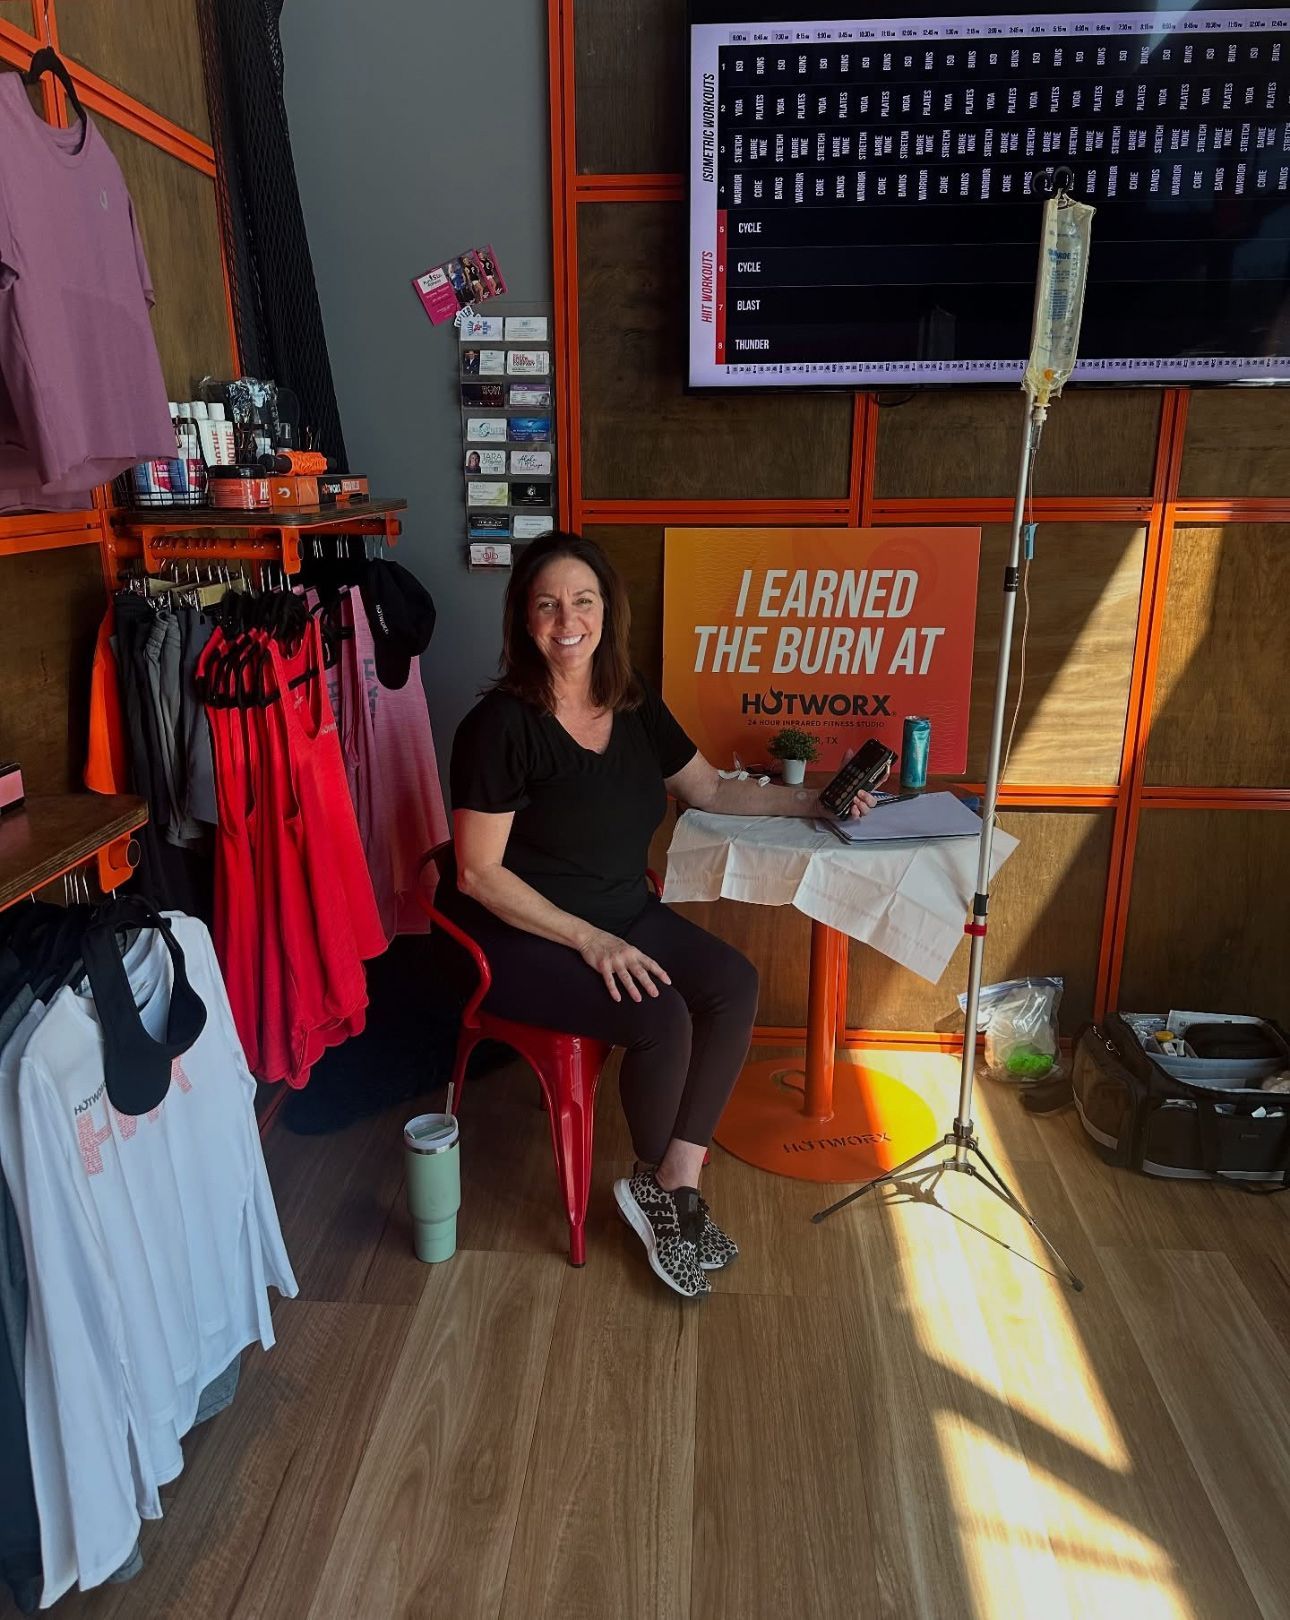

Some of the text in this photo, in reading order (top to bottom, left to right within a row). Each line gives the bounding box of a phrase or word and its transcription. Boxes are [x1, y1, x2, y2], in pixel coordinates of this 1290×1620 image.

[883, 53, 891, 70] BUNS
[925, 52, 933, 69] BUNS
[968, 51, 976, 68] BUNS
[1011, 50, 1019, 67] BUNS
[1054, 49, 1062, 66] BUNS
[1097, 48, 1105, 65] BUNS
[1140, 46, 1150, 64] BUNS
[1184, 46, 1192, 63] BUNS
[721, 63, 726, 71] 1
[839, 92, 847, 118] PILATES
[881, 91, 889, 116] PILATES
[923, 90, 931, 115] PILATES
[944, 94, 952, 111] YOGA
[966, 89, 974, 114] PILATES
[987, 93, 995, 110] YOGA
[1008, 88, 1016, 113] PILATES
[1051, 87, 1059, 112] PILATES
[1094, 86, 1102, 111] PILATES
[1116, 90, 1124, 106] YOGA
[1137, 85, 1146, 110] PILATES
[1159, 89, 1167, 105] YOGA
[1180, 84, 1189, 109] PILATES
[735, 100, 743, 116] YOGA
[703, 73, 715, 183] ISOMETRIC WORKOUTS
[1181, 130, 1189, 146] NONE
[817, 133, 825, 161] STRETCH
[875, 136, 883, 156] BARRE
[884, 136, 892, 153] NONE
[900, 131, 908, 158] STRETCH
[916, 135, 924, 155] BARRE
[942, 130, 950, 157] STRETCH
[958, 134, 966, 154] BARRE
[967, 134, 975, 151] NONE
[984, 129, 992, 156] STRETCH
[1000, 132, 1009, 153] BARRE
[1010, 133, 1018, 150] NONE
[1026, 128, 1035, 155] STRETCH
[1043, 132, 1051, 152] BARRE
[1053, 132, 1061, 149] NONE
[1069, 127, 1078, 154] STRETCH
[1086, 131, 1094, 151] BARRE
[1095, 132, 1103, 148] NONE
[1112, 126, 1120, 154] STRETCH
[1128, 130, 1137, 150] BARRE
[1138, 131, 1146, 147] NONE
[1154, 125, 1163, 153] STRETCH
[1171, 129, 1180, 149] BARRE
[775, 177, 783, 199] BANDS
[795, 173, 803, 203] WARRIOR
[857, 171, 865, 201] WARRIOR
[878, 177, 886, 195] CORE
[898, 175, 907, 197] BANDS
[919, 170, 927, 200] WARRIOR
[940, 176, 948, 193] CORE
[960, 173, 969, 195] BANDS
[981, 168, 990, 199] WARRIOR
[1002, 175, 1011, 192] CORE
[1024, 172, 1032, 194] BANDS
[1087, 170, 1096, 192] BANDS
[1108, 166, 1117, 196] WARRIOR
[1130, 172, 1138, 189] CORE
[1150, 169, 1159, 191] BANDS
[1172, 165, 1181, 195] WARRIOR
[1278, 166, 1288, 190] BANDS
[734, 175, 742, 204] WARRIOR
[754, 180, 762, 197] CORE
[738, 222, 762, 233] CYCLE
[737, 262, 761, 273] CYCLE
[702, 251, 713, 323] HIIT WORKOUTS
[737, 300, 760, 311] BLAST
[735, 339, 769, 350] THUNDER
[735, 569, 919, 619] I EARNED
[694, 626, 946, 675] THE BURN AT
[741, 686, 891, 716] HOTWORX
[759, 719, 781, 727] HOUR
[824, 720, 854, 728] FITNESS
[826, 736, 838, 745] TX
[783, 1132, 892, 1153] HOTWORX
